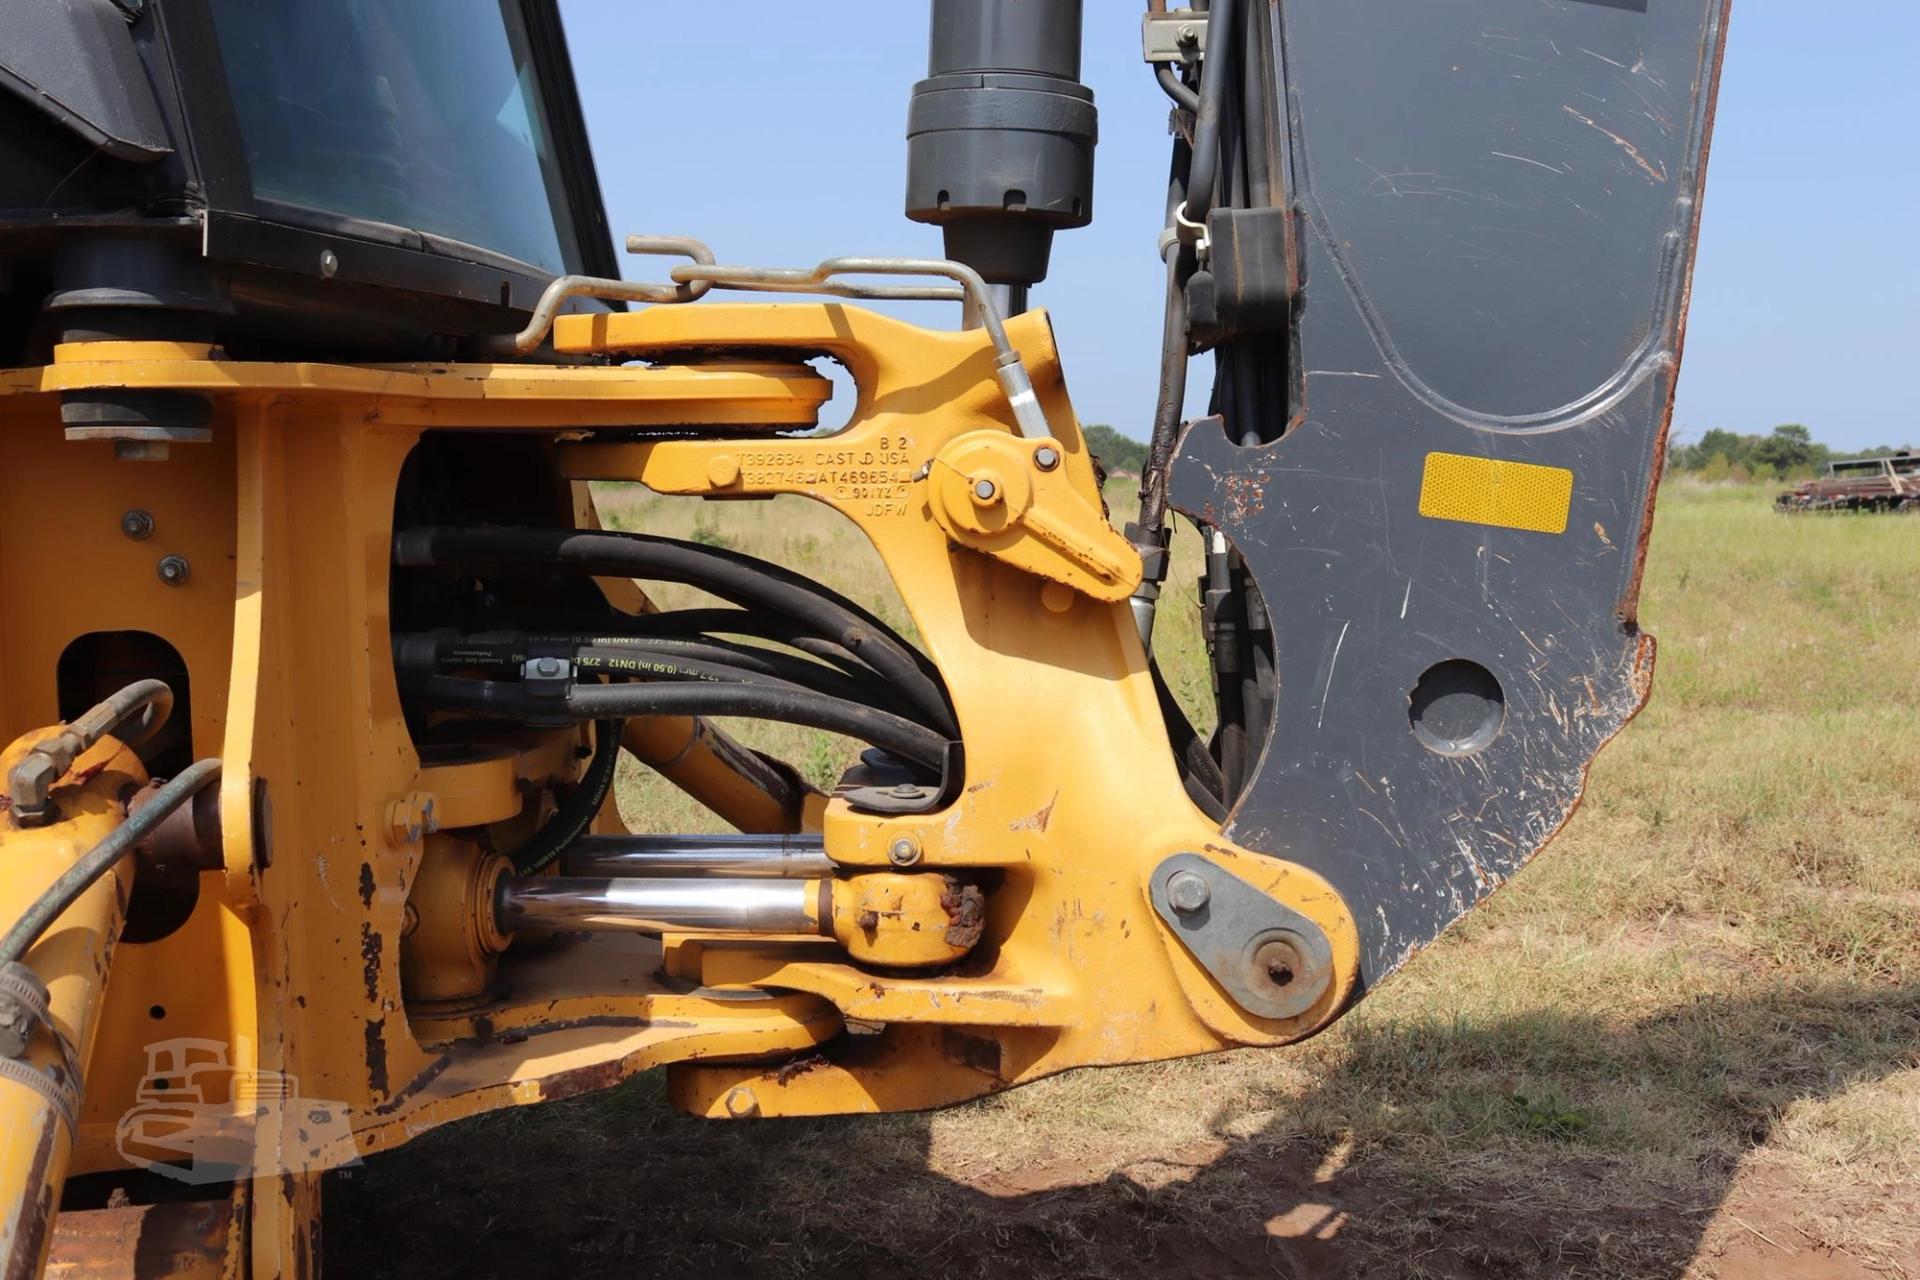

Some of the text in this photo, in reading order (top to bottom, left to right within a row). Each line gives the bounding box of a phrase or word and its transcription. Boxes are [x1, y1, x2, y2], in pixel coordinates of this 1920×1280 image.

[815, 452, 856, 465] CAST
[880, 452, 909, 465] USA
[866, 504, 907, 517] JDFW
[583, 657, 601, 667] 275
[608, 658, 636, 670] DN12
[638, 660, 651, 672] in)
[653, 663, 677, 675] (0.50
